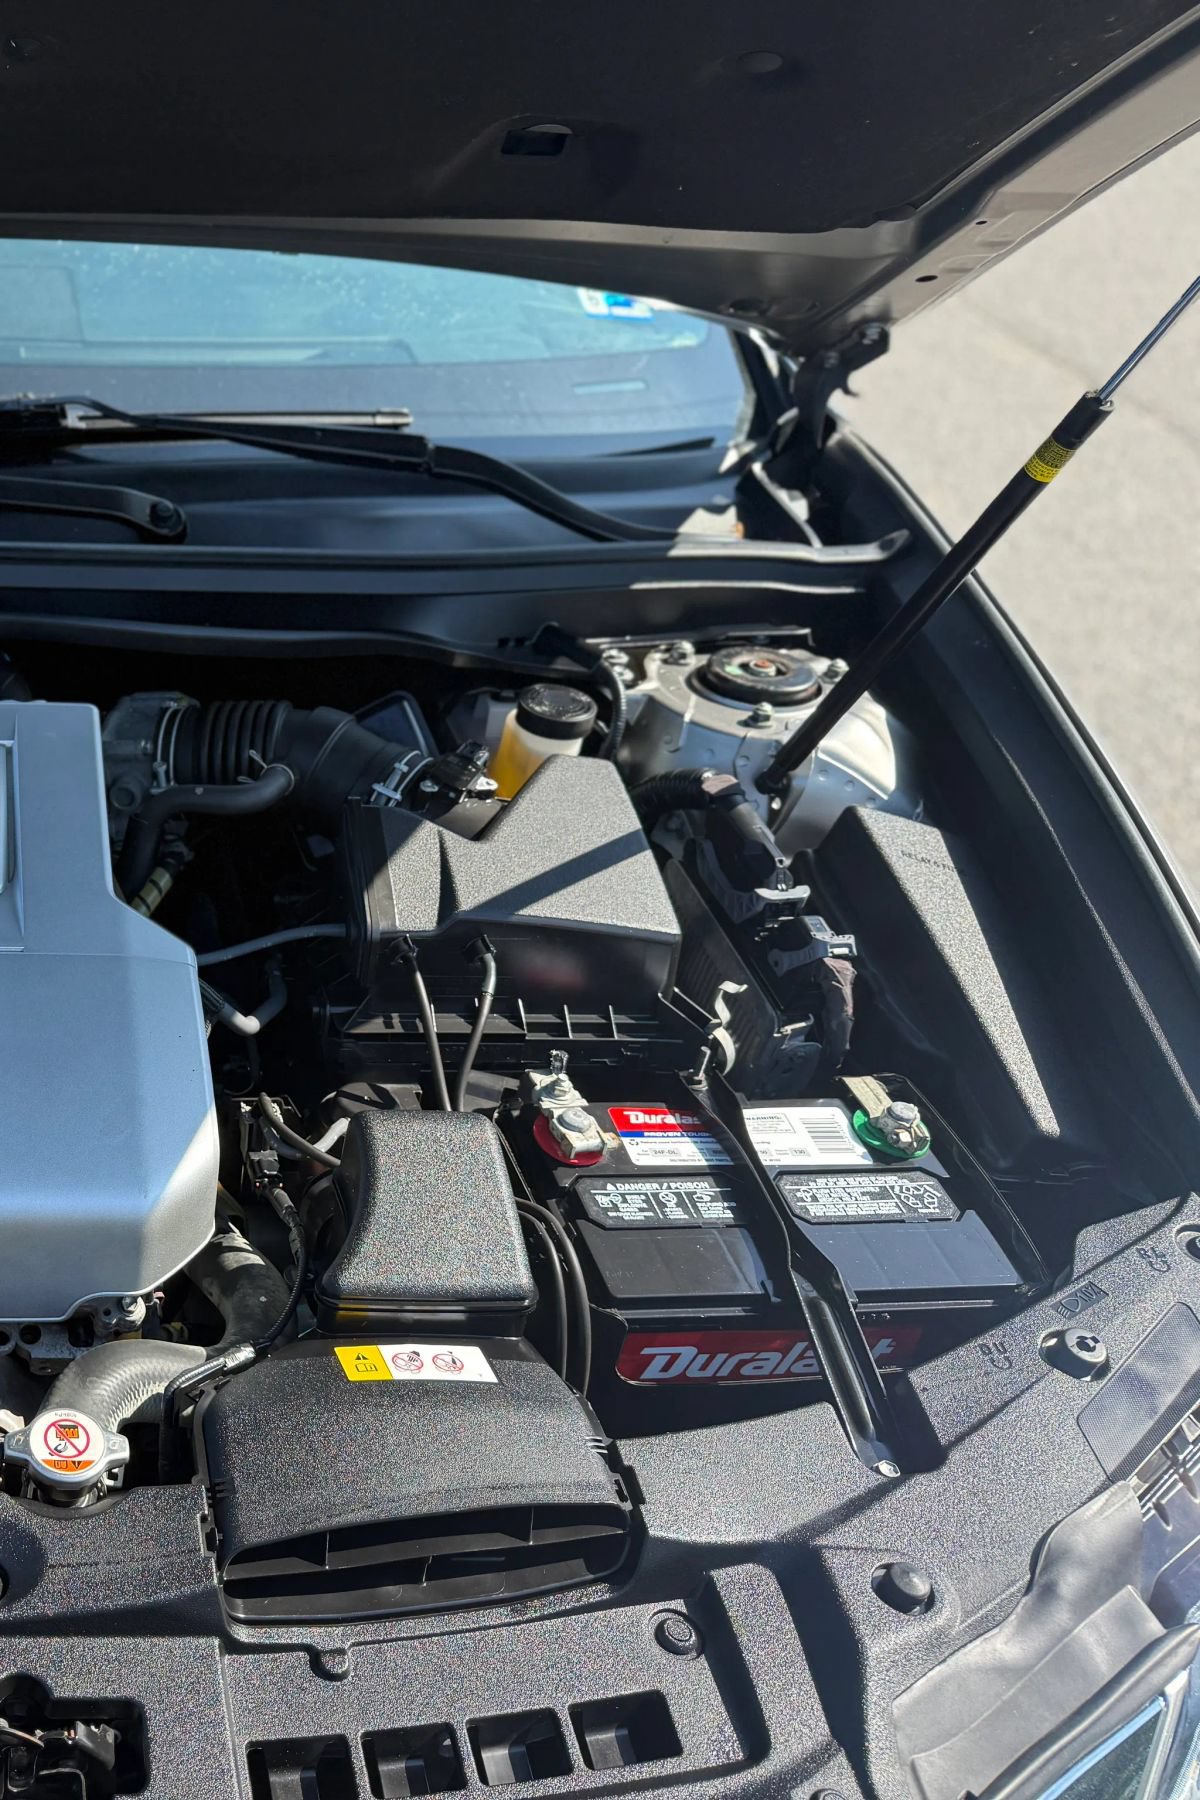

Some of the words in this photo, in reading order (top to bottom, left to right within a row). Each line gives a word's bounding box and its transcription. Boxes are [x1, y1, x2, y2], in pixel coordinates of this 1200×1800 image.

[615, 1182, 660, 1191] DANGER
[670, 1181, 710, 1190] POISON
[639, 1338, 897, 1380] Duralat
